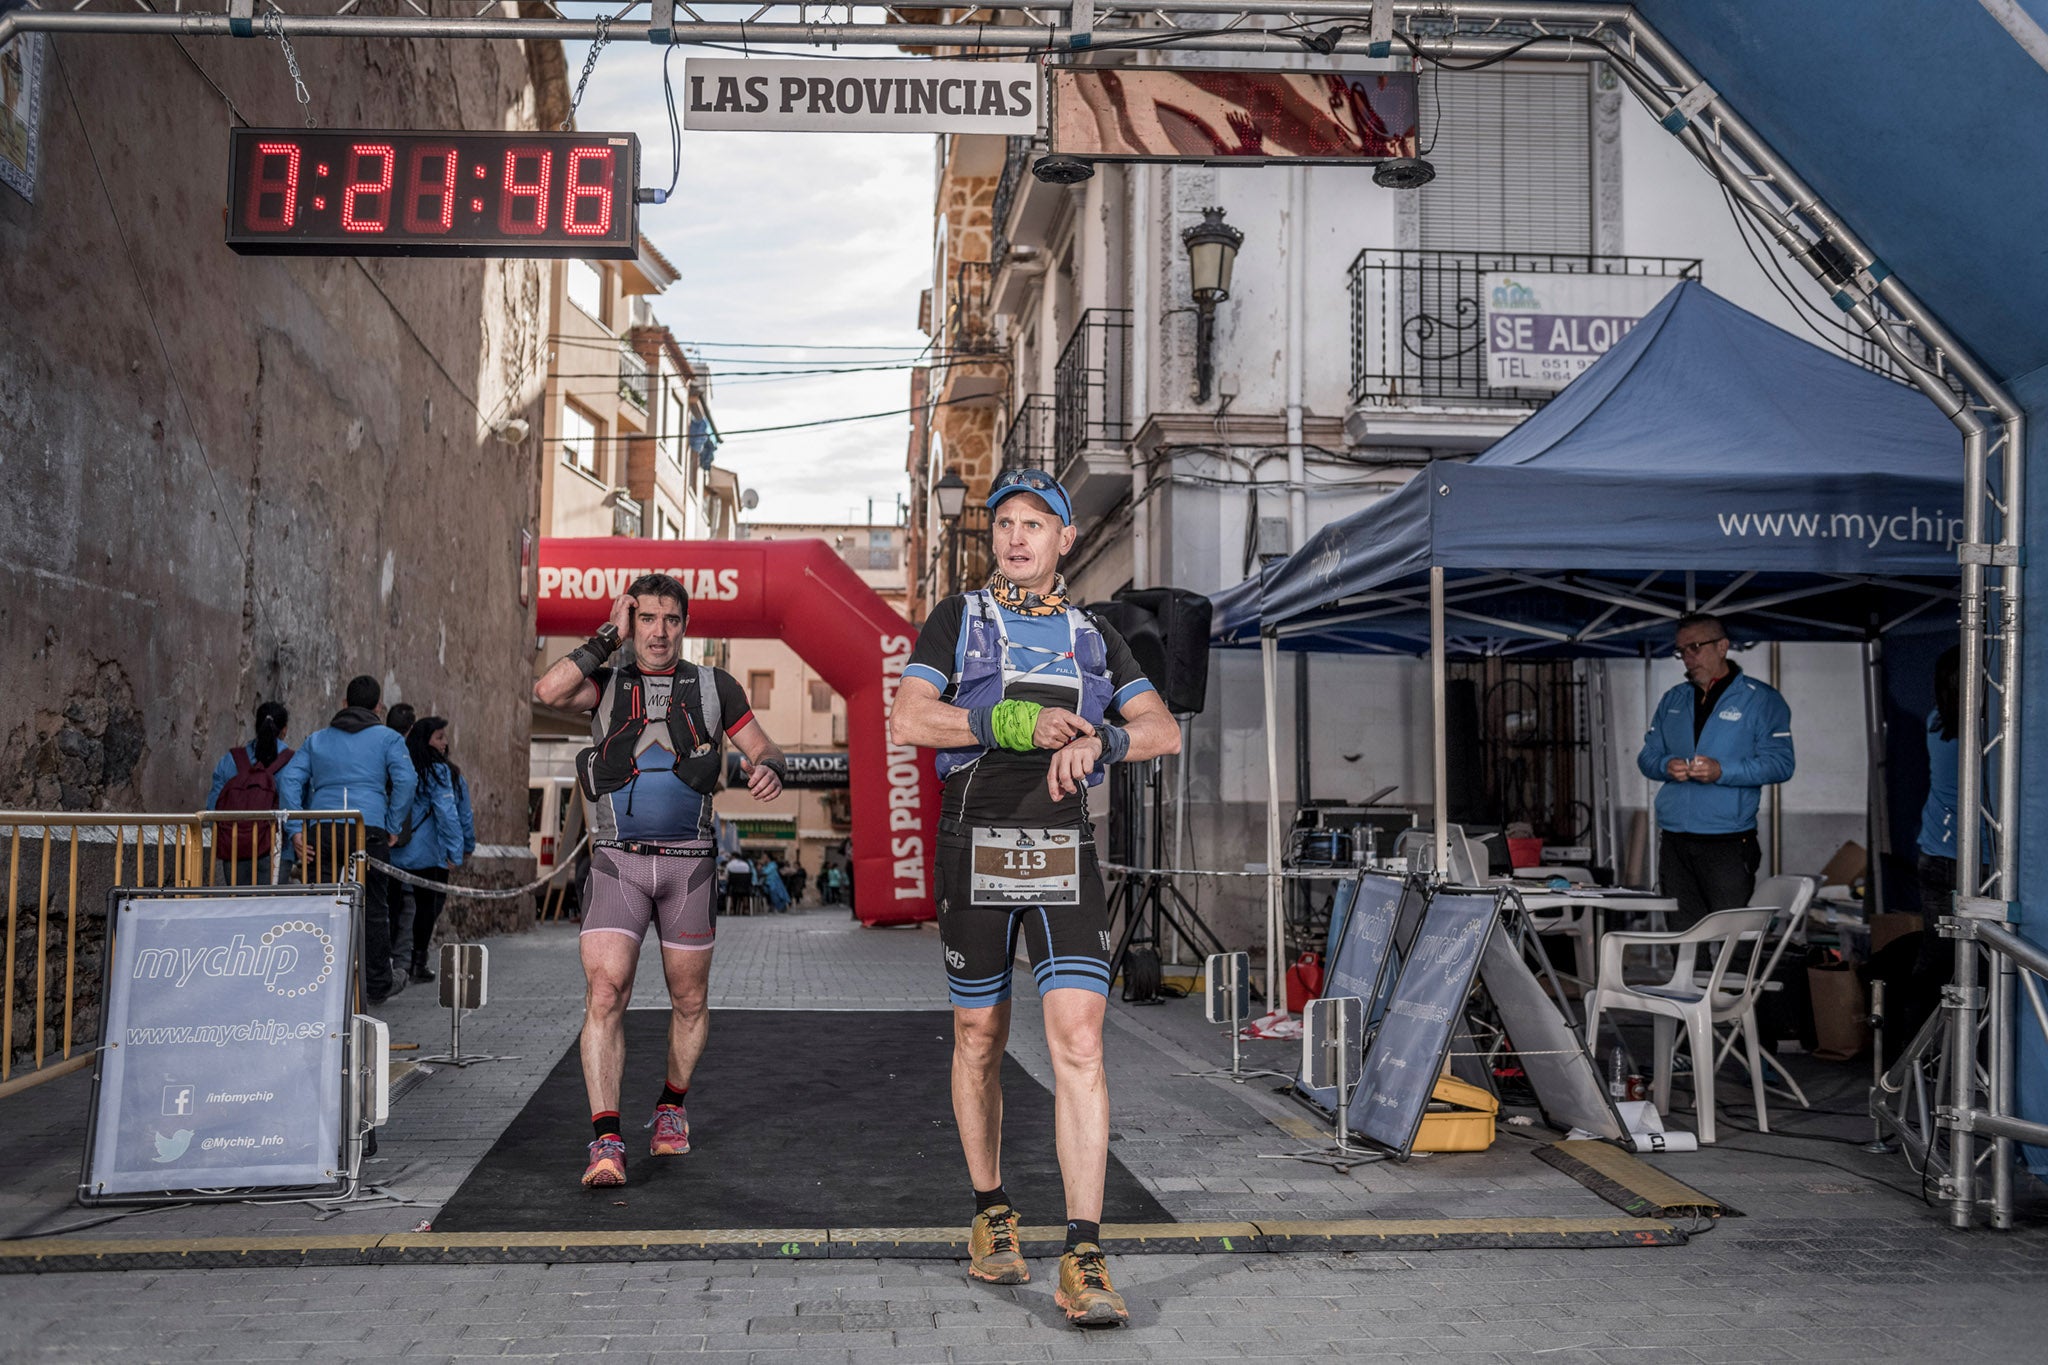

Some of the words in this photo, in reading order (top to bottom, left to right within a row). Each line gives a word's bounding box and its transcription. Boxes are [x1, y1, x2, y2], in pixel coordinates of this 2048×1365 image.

[690, 76, 768, 113] LAS
[779, 77, 1032, 117] PROVINCIAS
[258, 142, 613, 234] 7:21:46
[1495, 316, 1534, 350] SE
[1548, 318, 1637, 352] ALQU
[1542, 358, 1569, 369] 651
[1542, 371, 1571, 381] 964
[538, 567, 738, 600] PROVIAS
[891, 836, 926, 899] LAS
[1003, 850, 1047, 870] 113
[133, 934, 299, 988] mychip
[127, 1019, 325, 1047] www.mychip.es
[205, 1091, 274, 1104] /infomychip
[201, 1134, 284, 1150] @Mychip_Info
